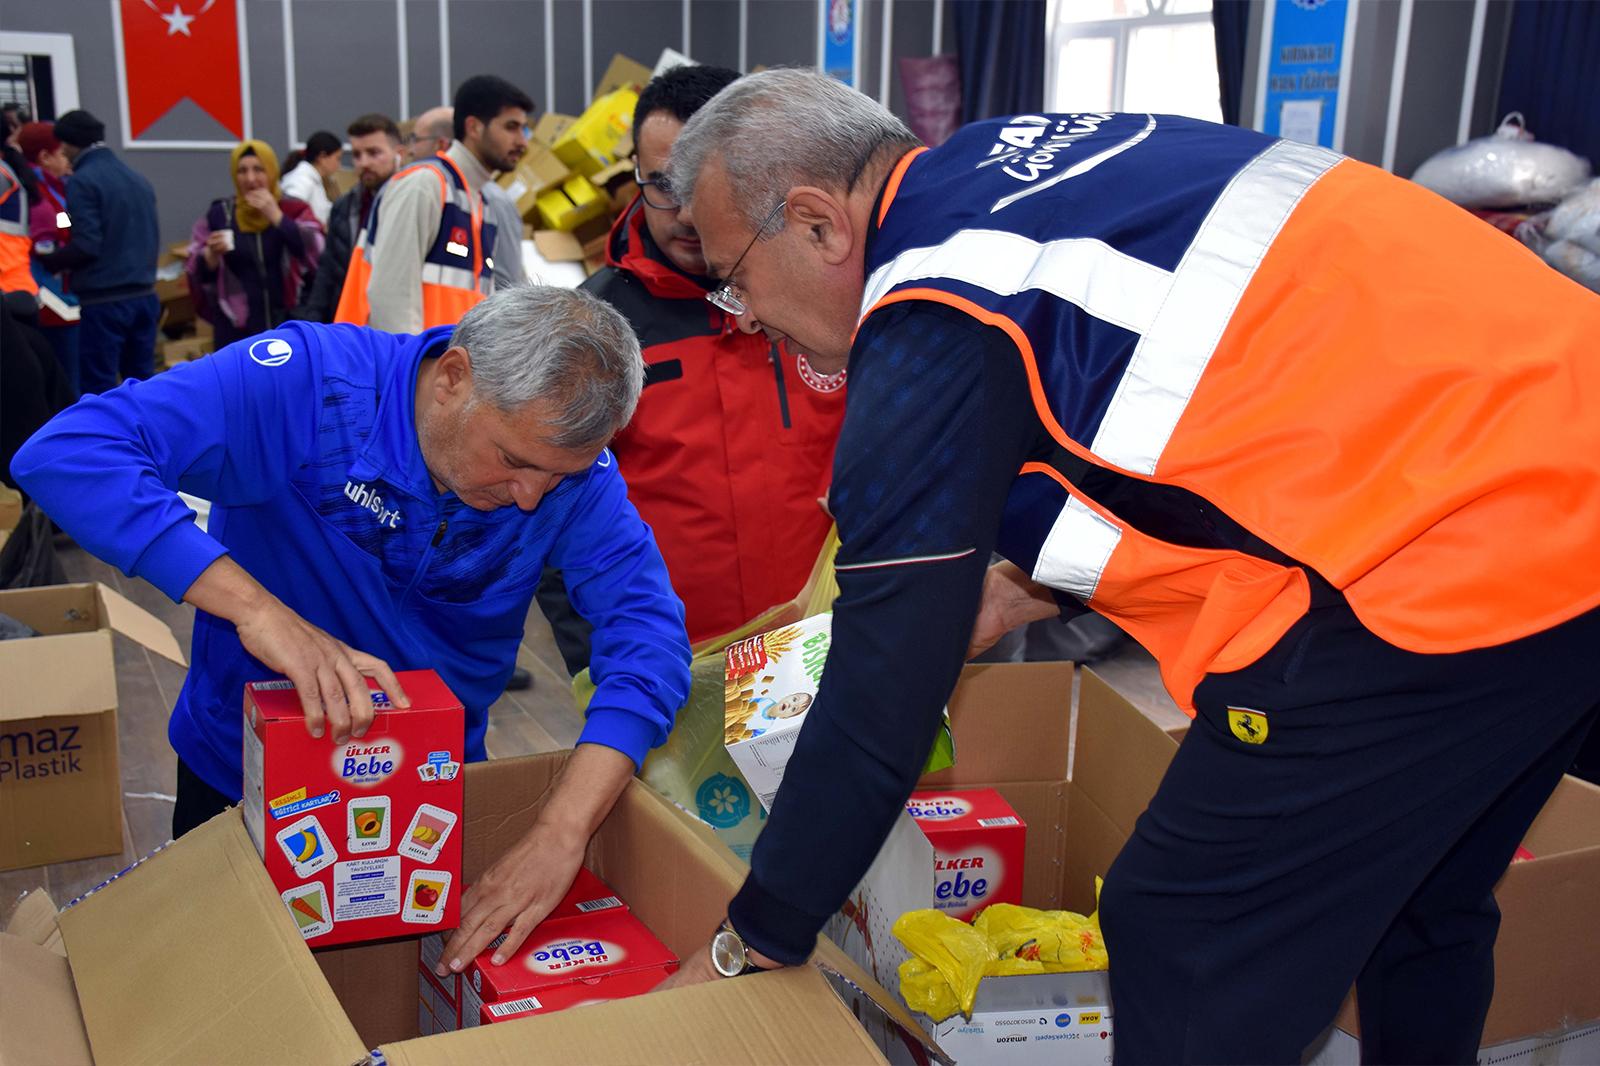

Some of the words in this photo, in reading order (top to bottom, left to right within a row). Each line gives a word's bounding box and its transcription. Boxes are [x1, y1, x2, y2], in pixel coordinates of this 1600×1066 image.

[346, 745, 391, 757] ÜLKER
[0, 751, 82, 783] Plastik
[342, 755, 393, 777] Bebe
[330, 791, 340, 803] 2
[906, 806, 966, 818] Bebe
[935, 857, 984, 871] LKER
[936, 871, 988, 899] ebe
[534, 941, 606, 961] Bebe
[547, 954, 609, 970] ÜLKER
